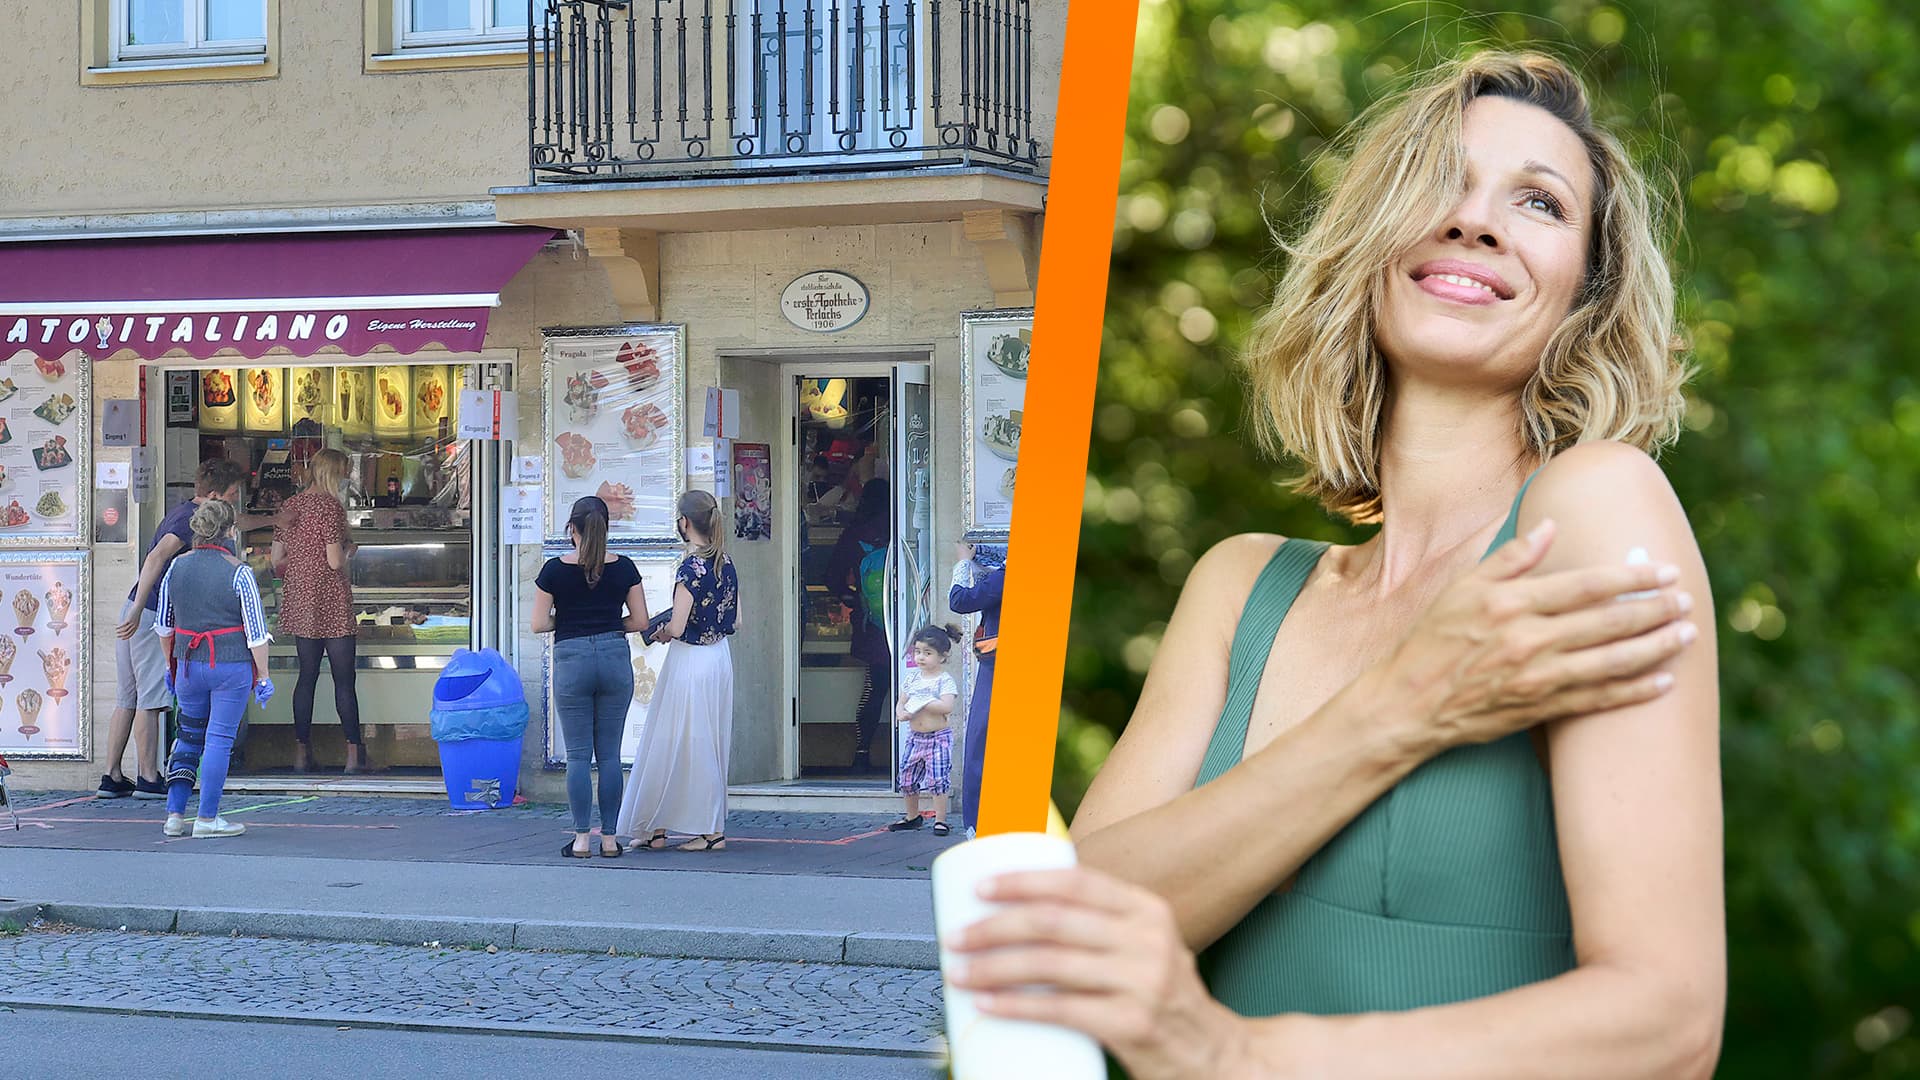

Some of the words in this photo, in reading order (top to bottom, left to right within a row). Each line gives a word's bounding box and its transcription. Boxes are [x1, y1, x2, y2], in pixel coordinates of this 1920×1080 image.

[793, 294, 815, 308] erste
[814, 292, 858, 310] Apotheke
[805, 308, 842, 320] Perlachs
[814, 320, 834, 328] 1906
[6, 316, 91, 343] ATO
[118, 314, 349, 342] ITALIANO
[367, 319, 407, 332] Eigene
[408, 318, 477, 331] Herstellung
[560, 350, 587, 358] Fragola
[464, 425, 486, 433] Eingang
[4, 573, 43, 581] Wundertüte
